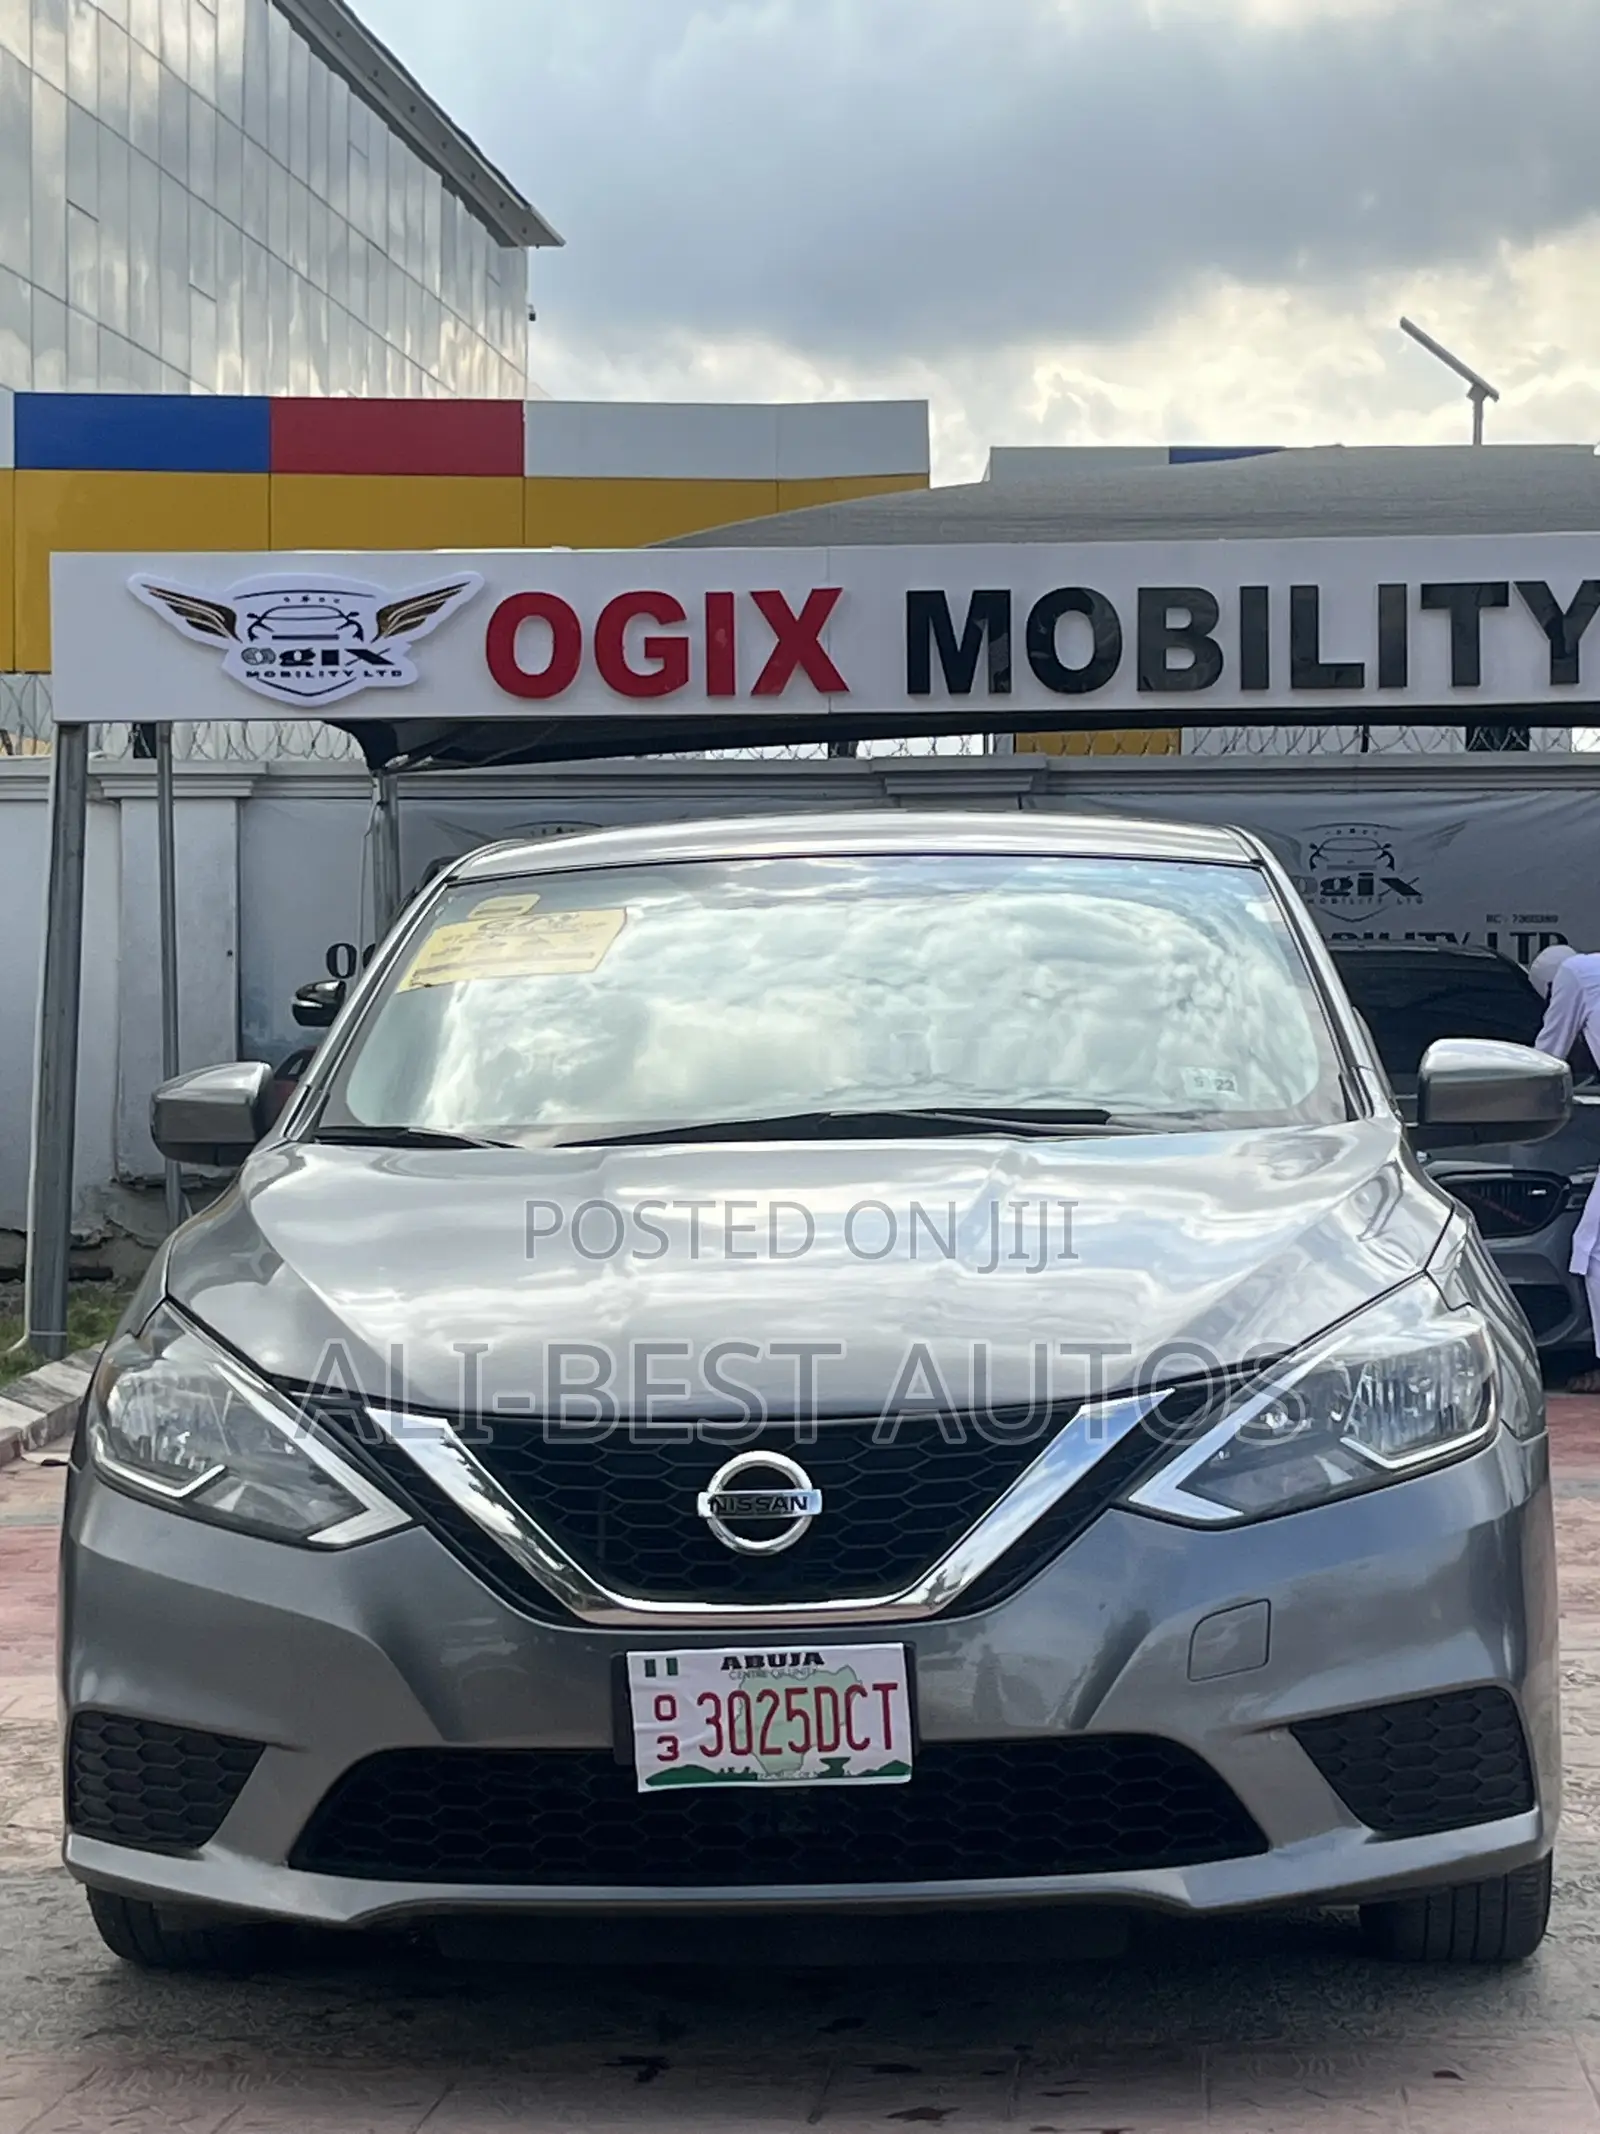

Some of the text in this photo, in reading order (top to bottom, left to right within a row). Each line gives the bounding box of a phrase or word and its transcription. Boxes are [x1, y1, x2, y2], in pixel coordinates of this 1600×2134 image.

[485, 579, 1600, 700] OGIX MOBILITY
[246, 670, 403, 678] MOBILITY LTD
[708, 1495, 808, 1513] NISSAN
[721, 1653, 824, 1670] ABUJA
[696, 1682, 899, 1758] 3025DCT
